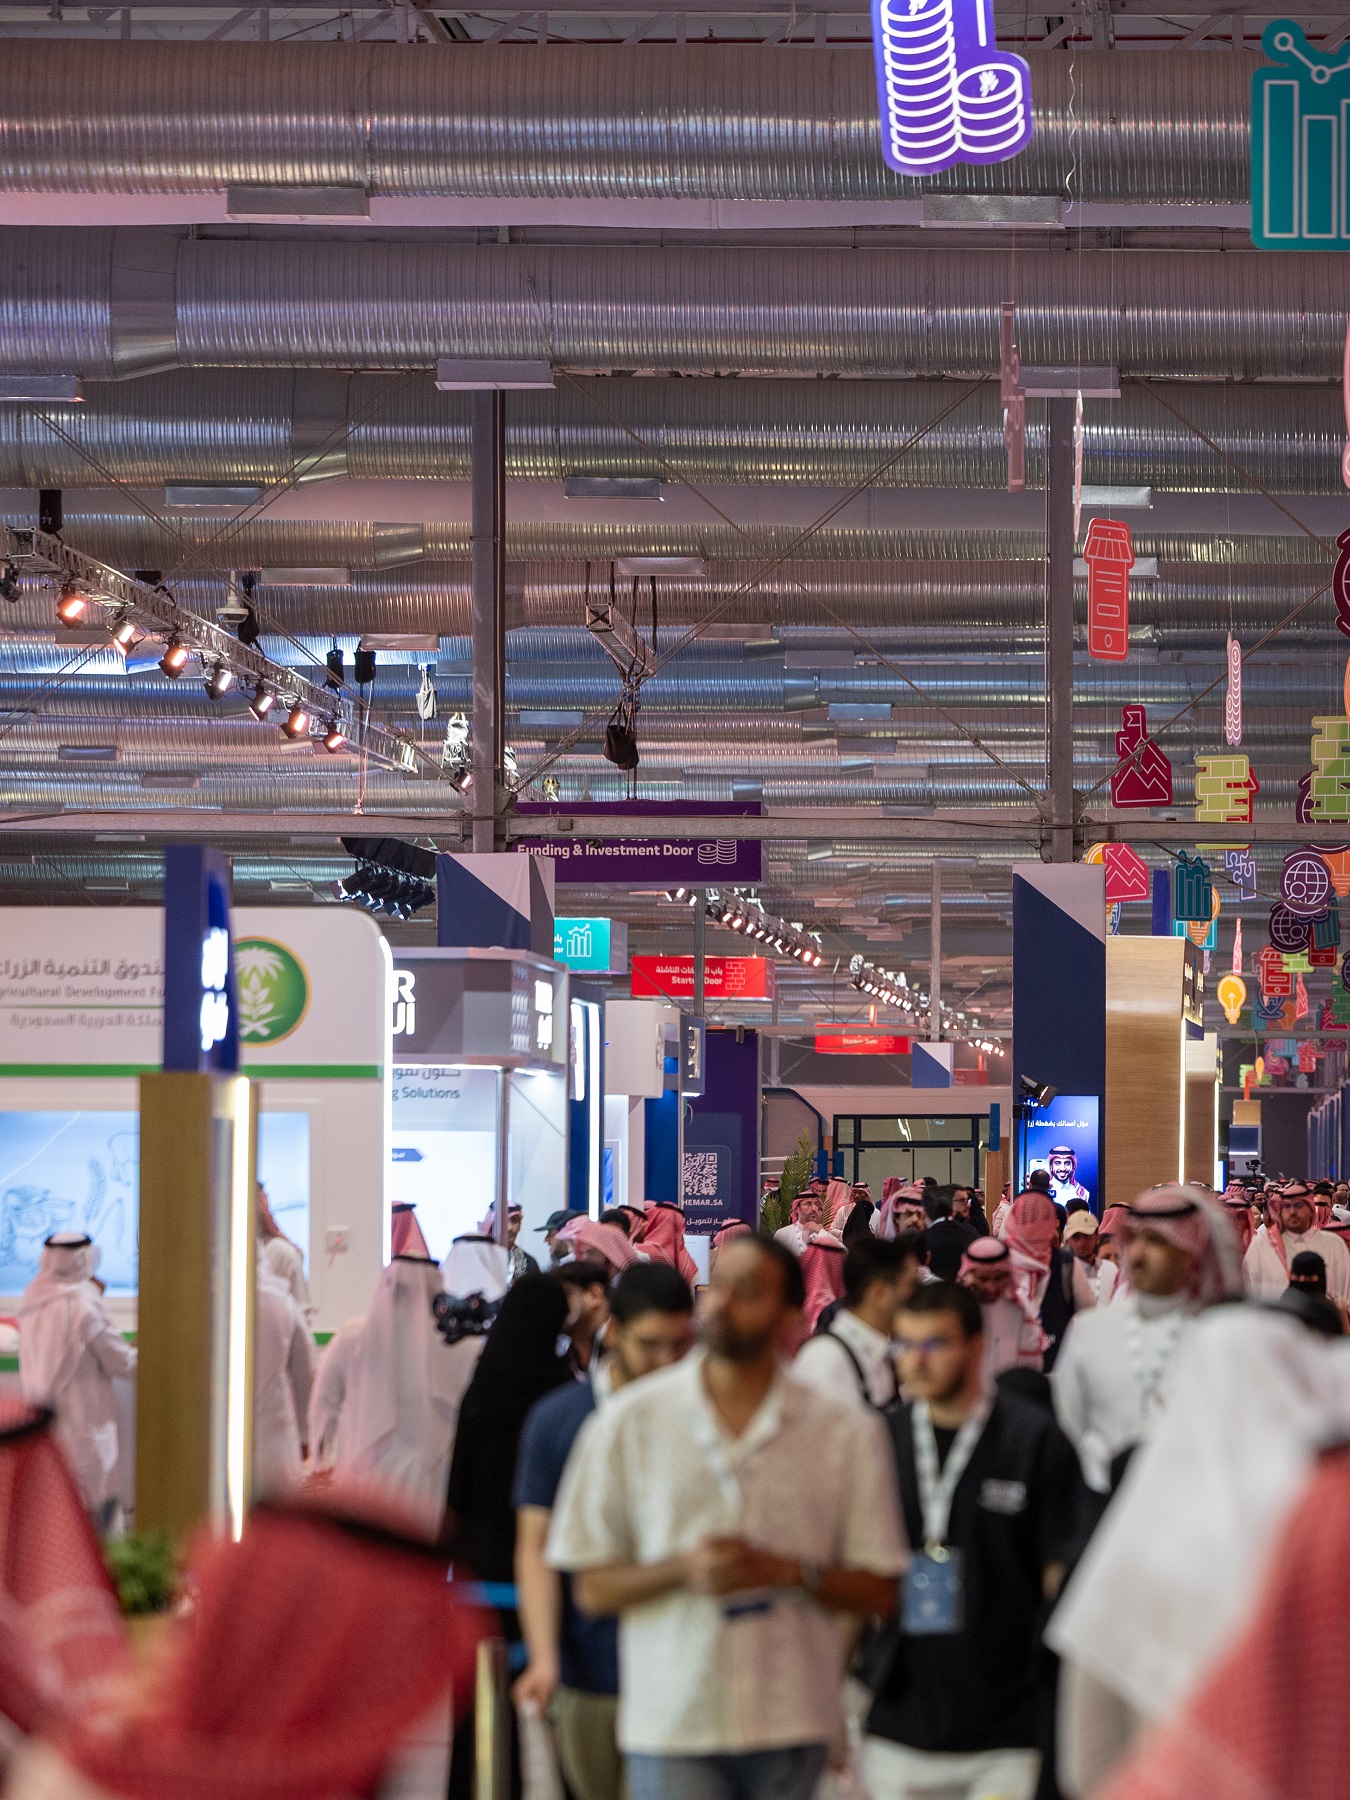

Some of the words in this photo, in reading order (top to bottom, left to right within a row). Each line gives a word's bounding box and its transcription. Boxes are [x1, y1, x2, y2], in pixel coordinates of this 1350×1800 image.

[517, 845, 570, 859] Funding
[573, 845, 583, 856] &
[585, 845, 661, 856] Investment
[663, 845, 694, 856] Door
[704, 977, 722, 985] Door
[402, 1086, 460, 1099] Solutions
